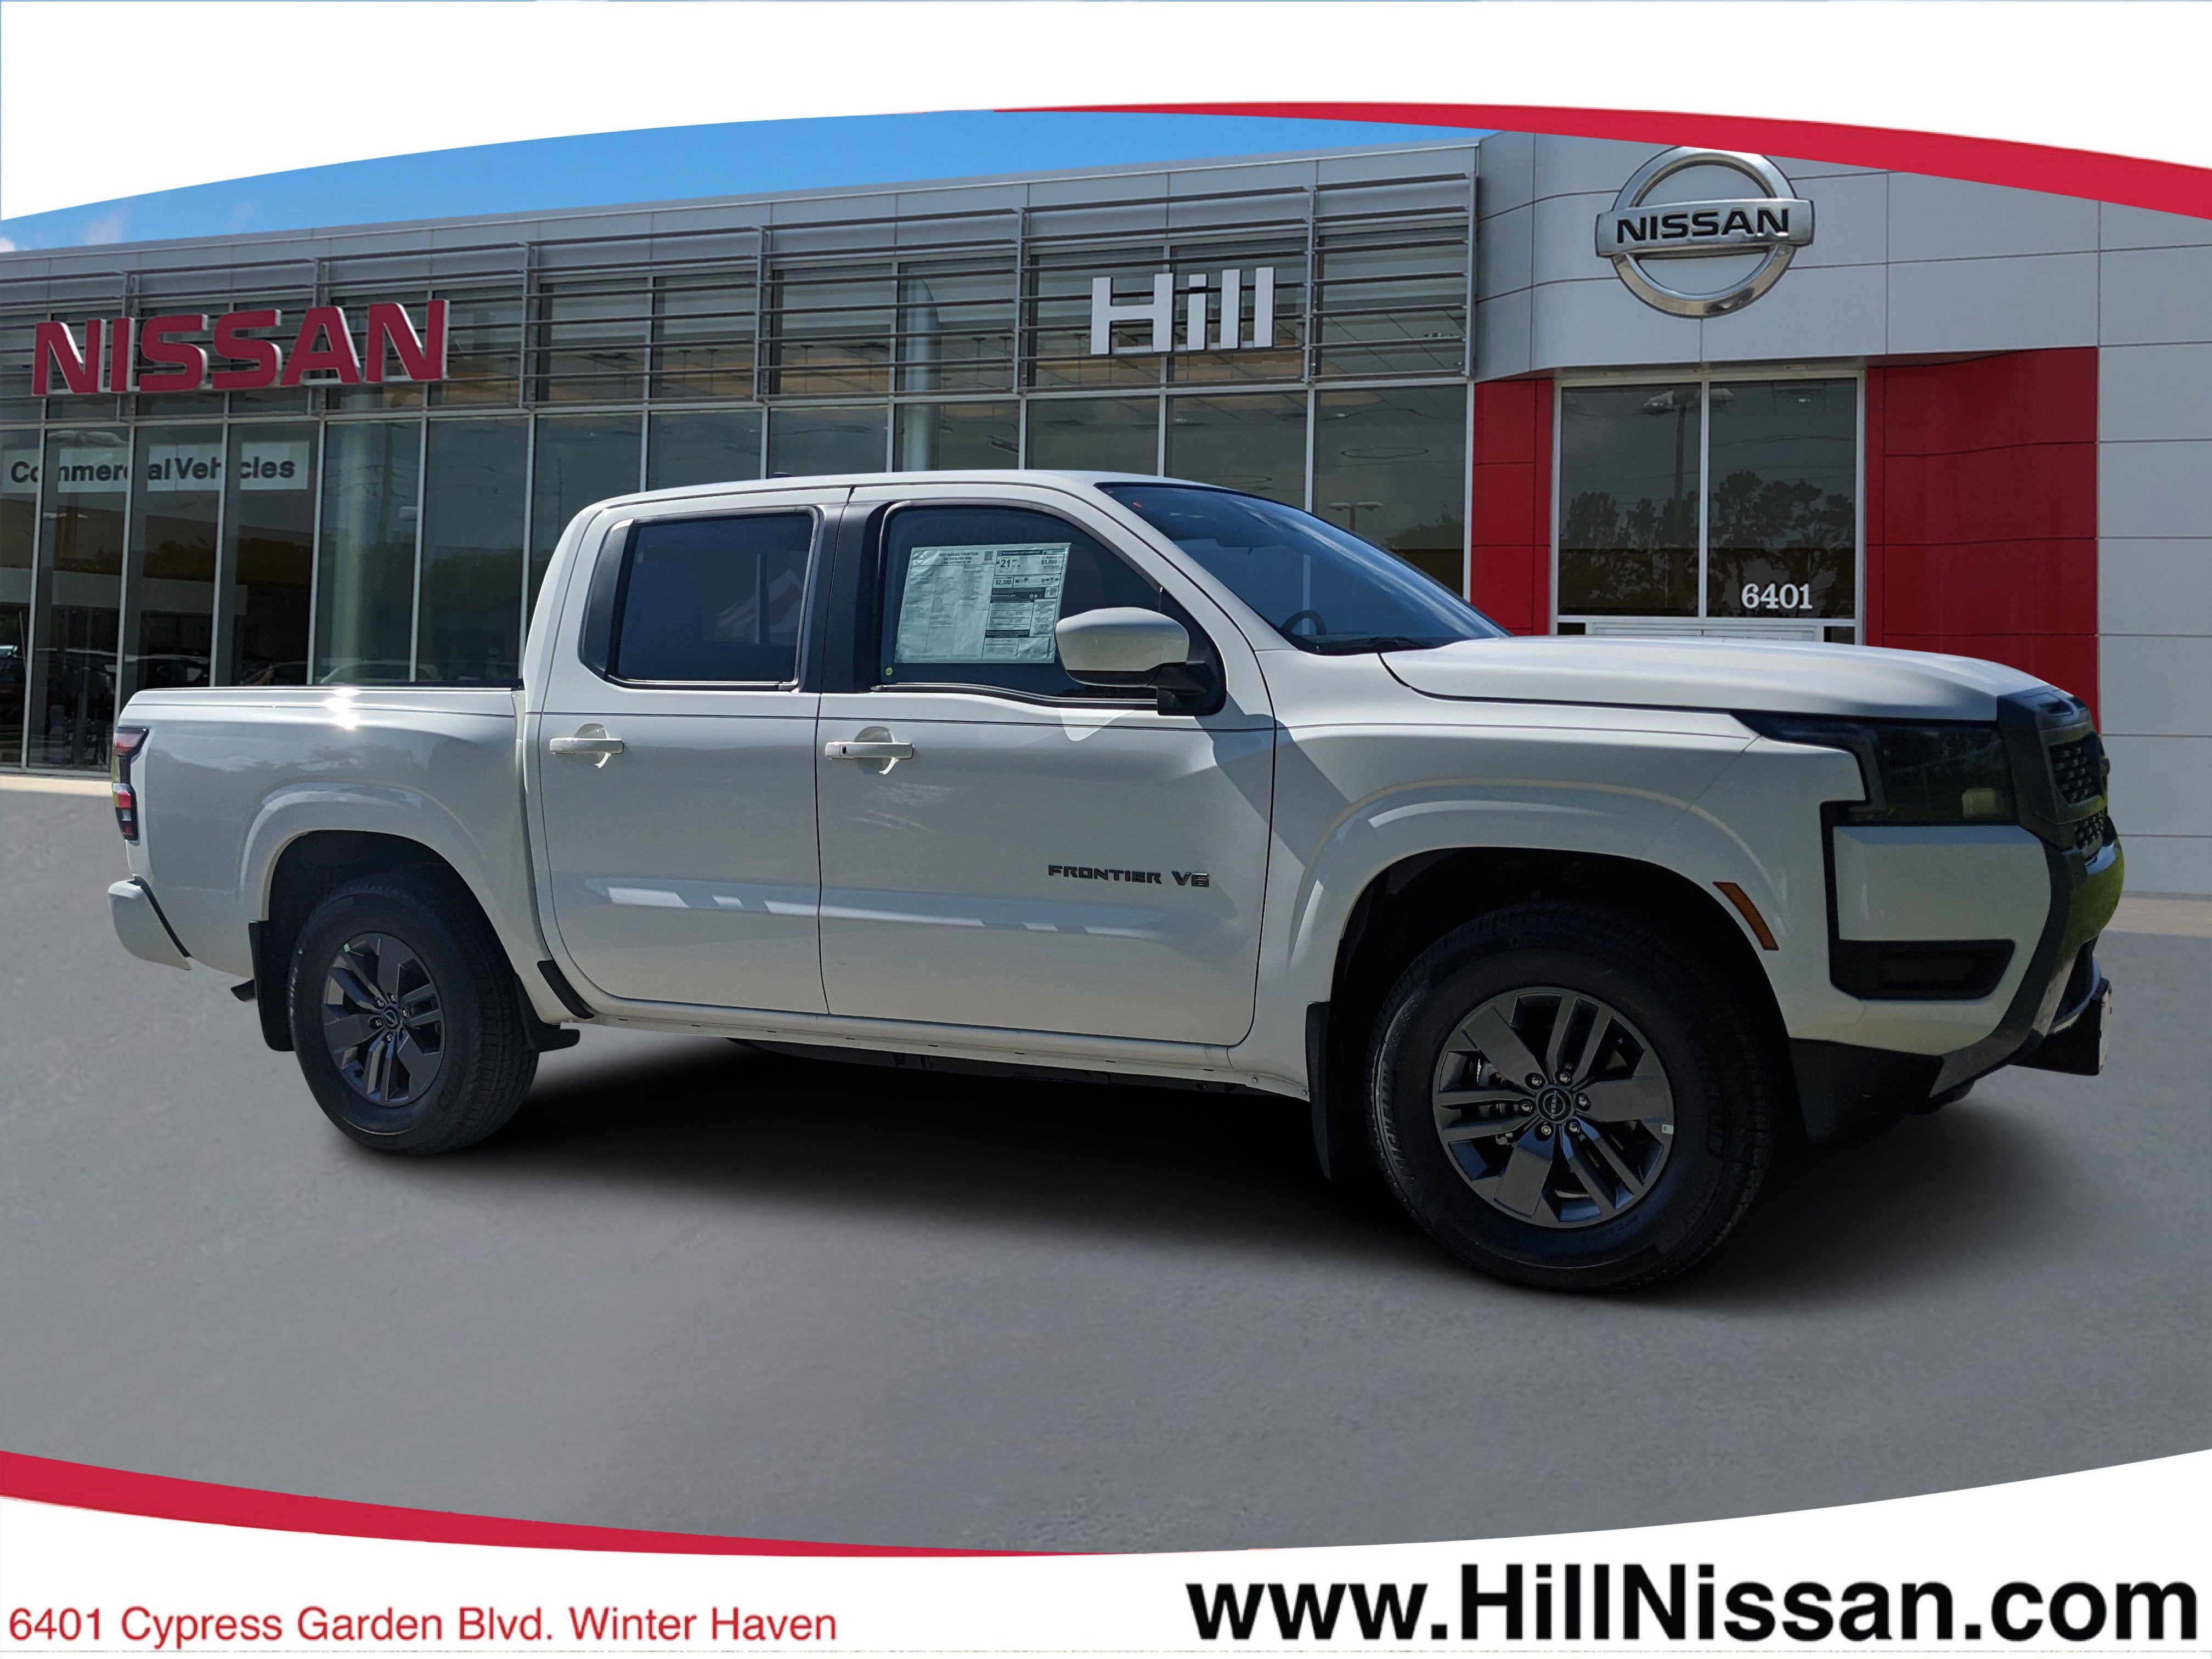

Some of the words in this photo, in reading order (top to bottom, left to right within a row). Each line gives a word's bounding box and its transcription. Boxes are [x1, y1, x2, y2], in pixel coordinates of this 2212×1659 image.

[1617, 207, 1789, 244] NISSAN
[1090, 266, 1276, 356] Hill
[32, 300, 449, 397] NISSAN
[1000, 559, 1011, 568] 21
[1741, 583, 1813, 609] 6401
[1048, 864, 1162, 885] FRONTIER
[1171, 871, 1210, 888] V6
